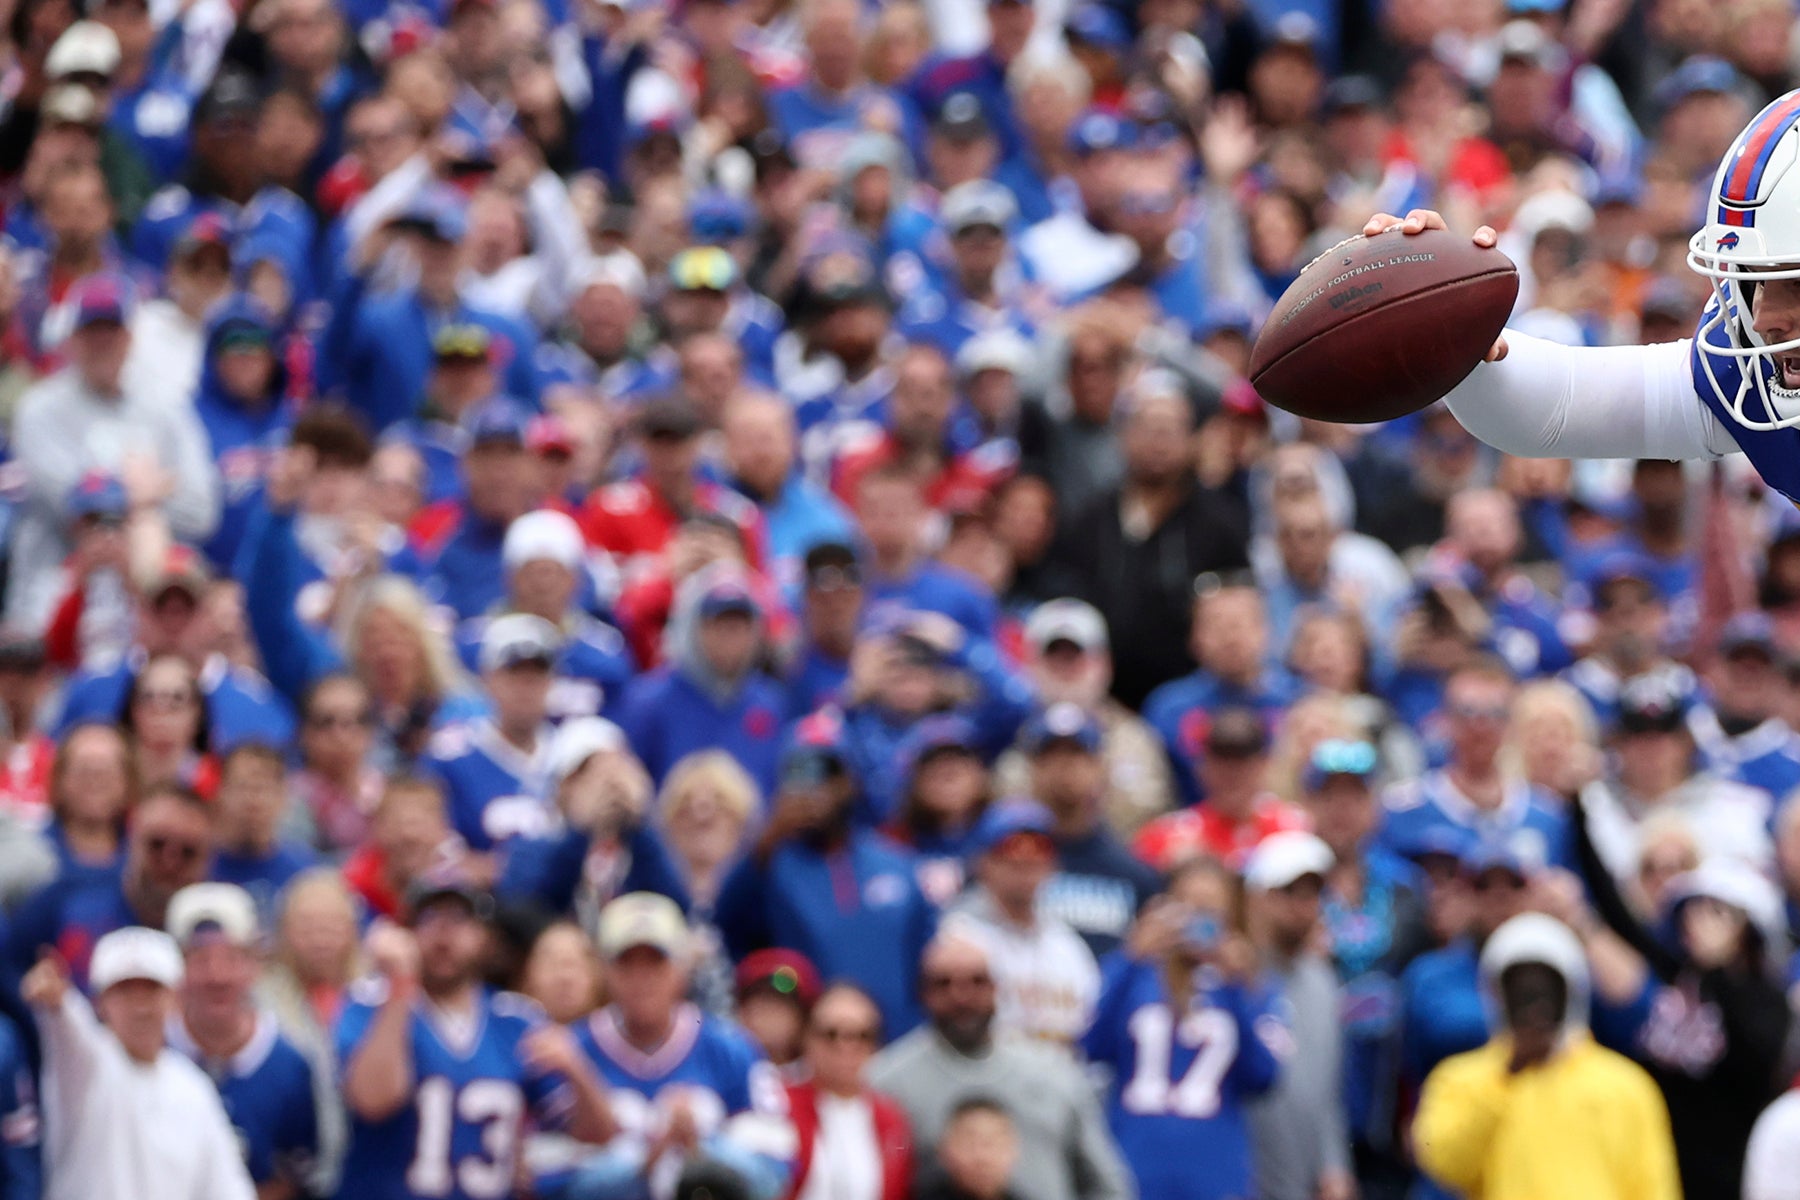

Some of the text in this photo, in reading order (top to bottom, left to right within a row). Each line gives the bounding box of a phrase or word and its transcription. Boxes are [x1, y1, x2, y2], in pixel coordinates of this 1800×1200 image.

[1282, 288, 1325, 325] NATIONAL
[1327, 260, 1385, 288] FOOTBALL
[1389, 253, 1435, 265] LEAGUE
[1121, 1003, 1239, 1119] 17
[405, 1073, 525, 1200] 13
